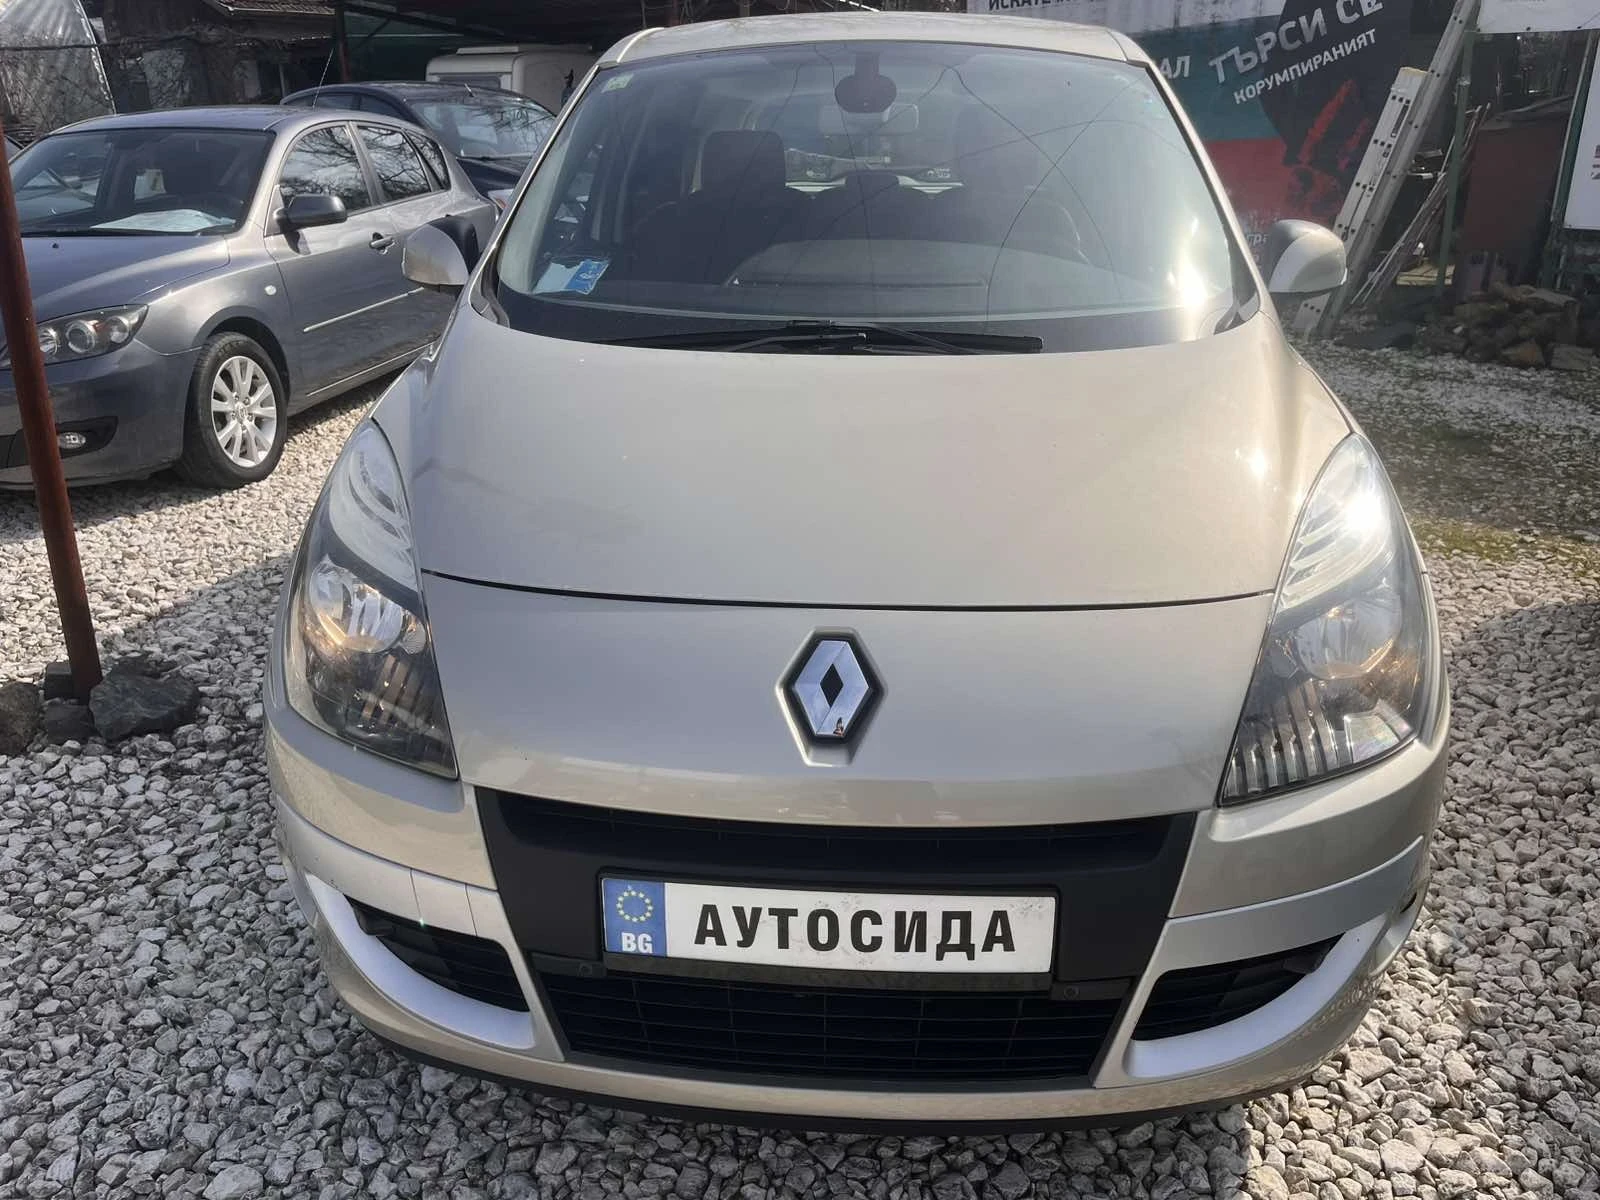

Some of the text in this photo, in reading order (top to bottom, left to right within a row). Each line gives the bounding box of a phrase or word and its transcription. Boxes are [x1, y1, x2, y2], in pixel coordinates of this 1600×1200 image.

[1208, 7, 1328, 84] ТЪРСИ
[1233, 28, 1376, 104] КОРУМПИРАНИЯТ
[621, 931, 653, 954] BG
[694, 903, 1016, 961] АУТОСИДА
